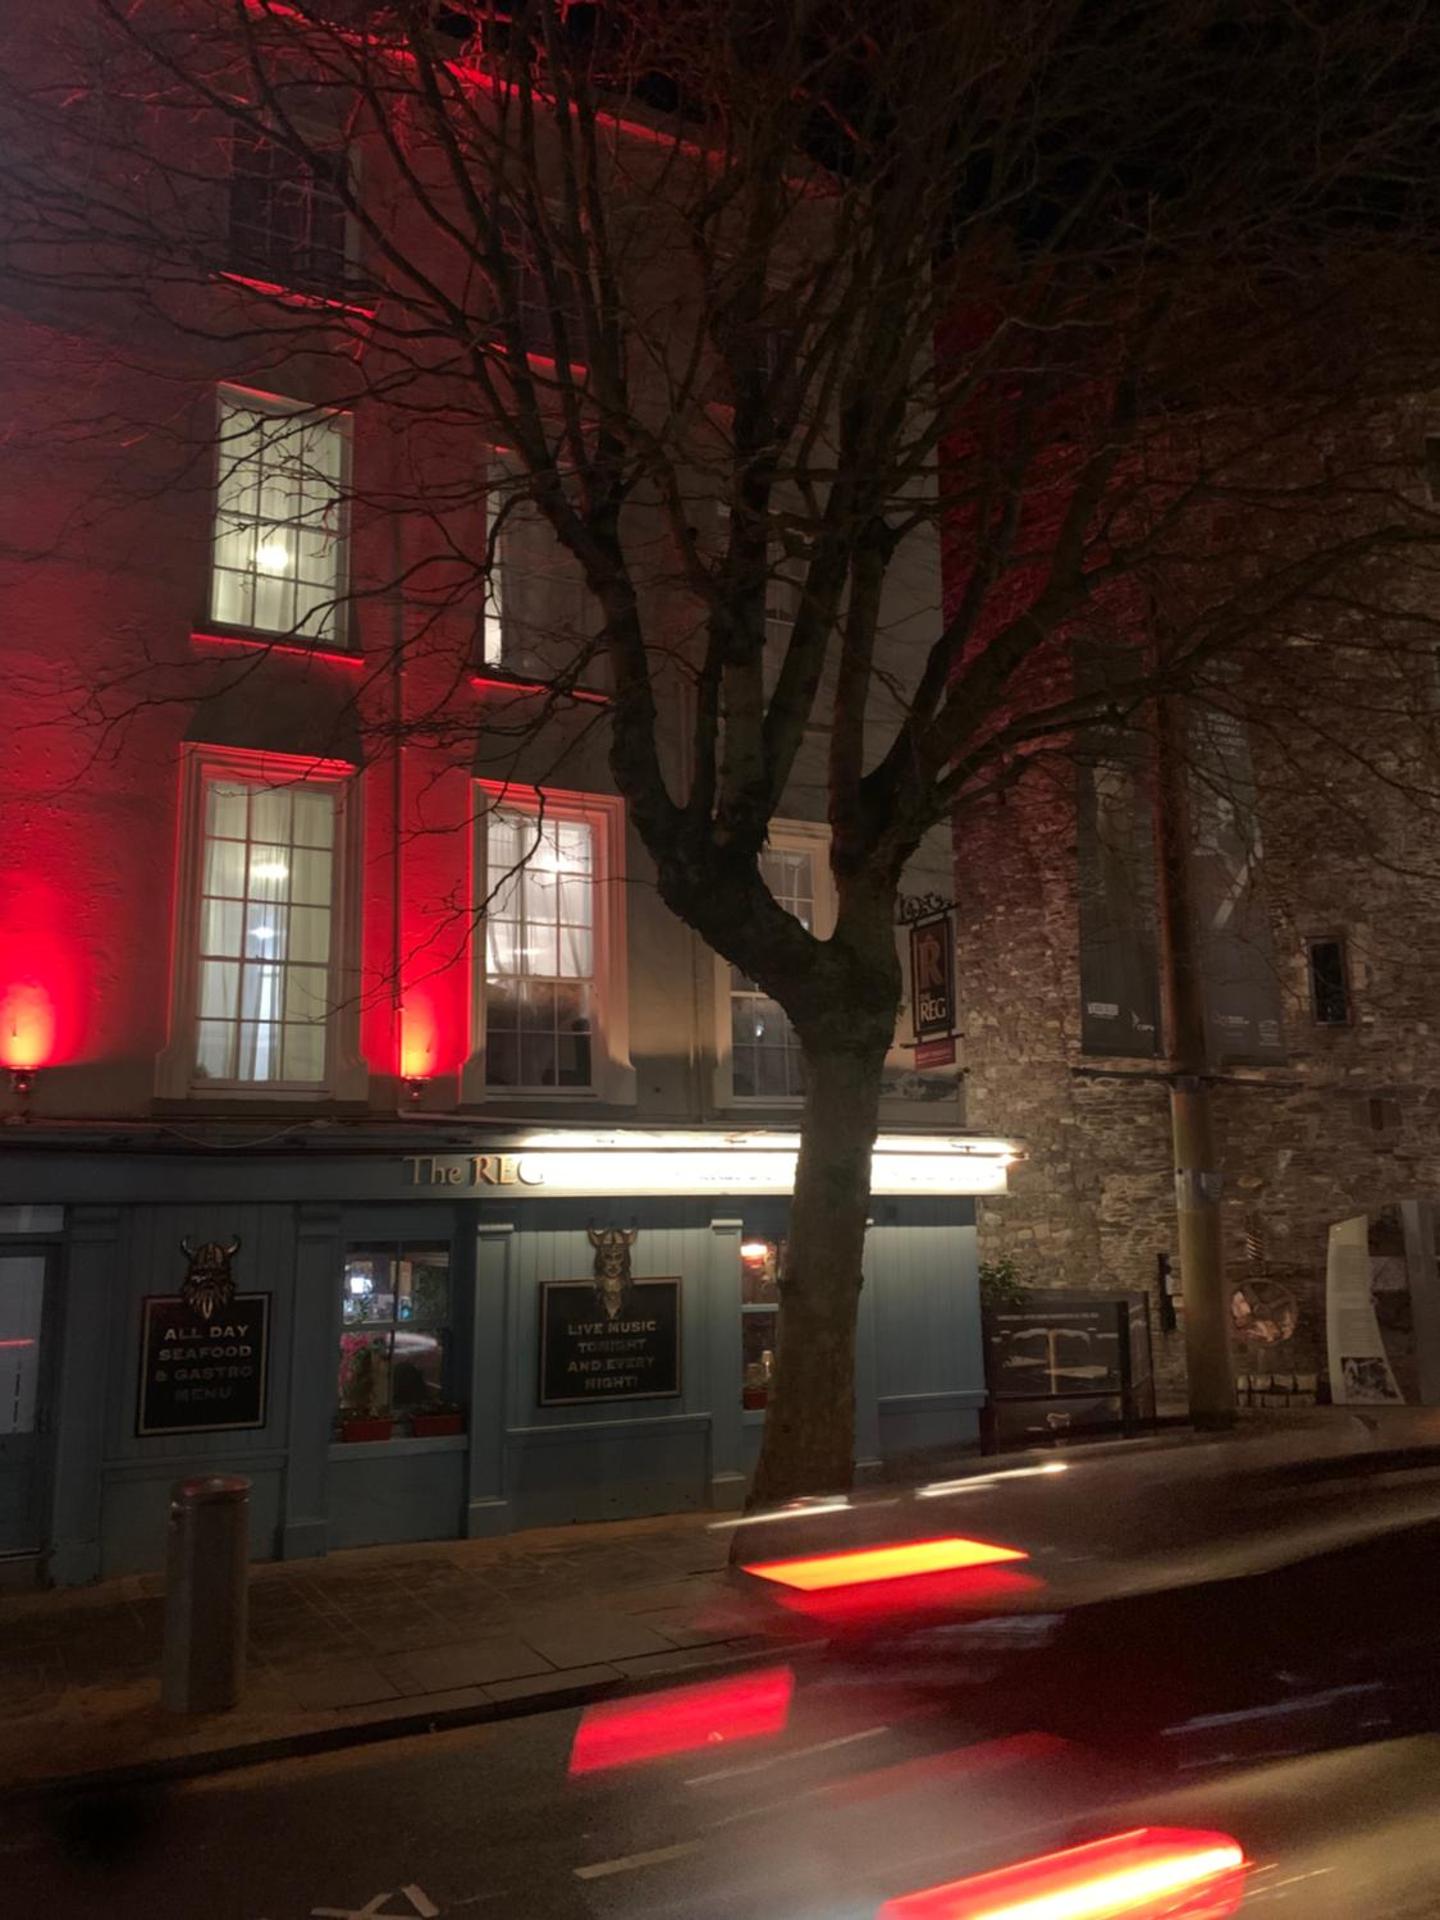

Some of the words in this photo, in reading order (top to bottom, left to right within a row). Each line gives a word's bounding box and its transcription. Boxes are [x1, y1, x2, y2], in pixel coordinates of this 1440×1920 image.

[919, 998, 946, 1022] REG
[403, 1156, 462, 1185] The
[164, 1328, 203, 1341] ALL
[209, 1325, 249, 1338] DAY
[567, 1323, 604, 1336] LIVE
[607, 1320, 657, 1334] MUSIC
[158, 1345, 253, 1361] SEAFOOD
[577, 1338, 648, 1354] TONIGHT
[567, 1360, 602, 1373] AND
[606, 1356, 656, 1370] EVERY
[155, 1369, 168, 1382] &
[174, 1366, 254, 1380] GASTRO
[175, 1386, 233, 1402] MENU
